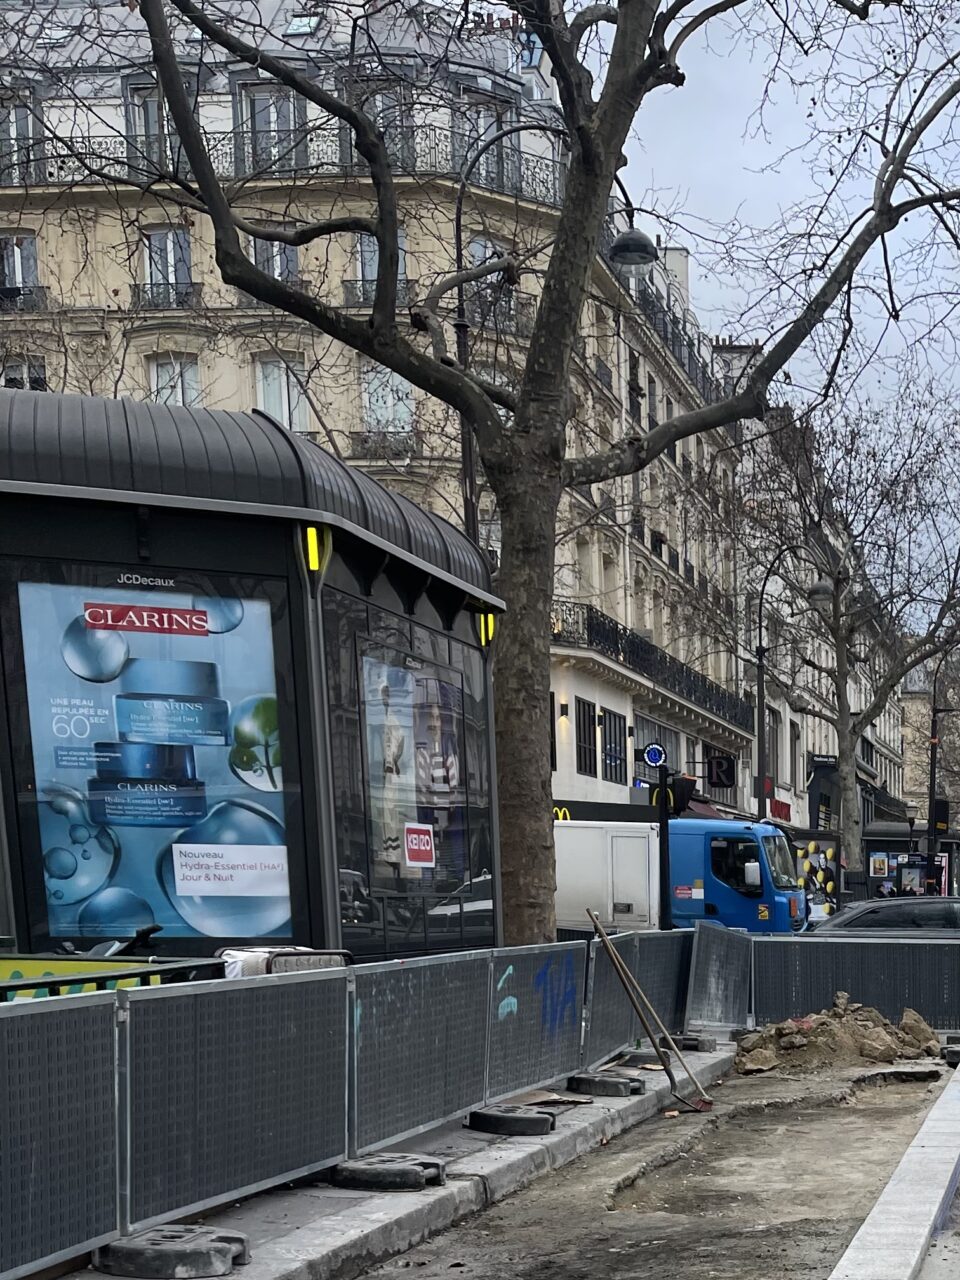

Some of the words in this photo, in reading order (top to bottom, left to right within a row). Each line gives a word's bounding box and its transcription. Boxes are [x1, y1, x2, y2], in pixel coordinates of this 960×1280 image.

[117, 573, 175, 587] JCDecaux
[84, 607, 208, 631] CLARINS
[71, 698, 94, 706] PEAU
[143, 700, 203, 711] CLARINS
[97, 708, 109, 716] EN
[52, 714, 90, 738] 60
[712, 757, 730, 786] R
[117, 782, 177, 792] CLARINS
[407, 833, 431, 850] KENZO
[179, 850, 224, 859] Nouveau
[180, 862, 258, 871] Hydra-Essentiel
[180, 873, 203, 882] Jour
[204, 873, 211, 881] &
[213, 874, 234, 882] Nuit
